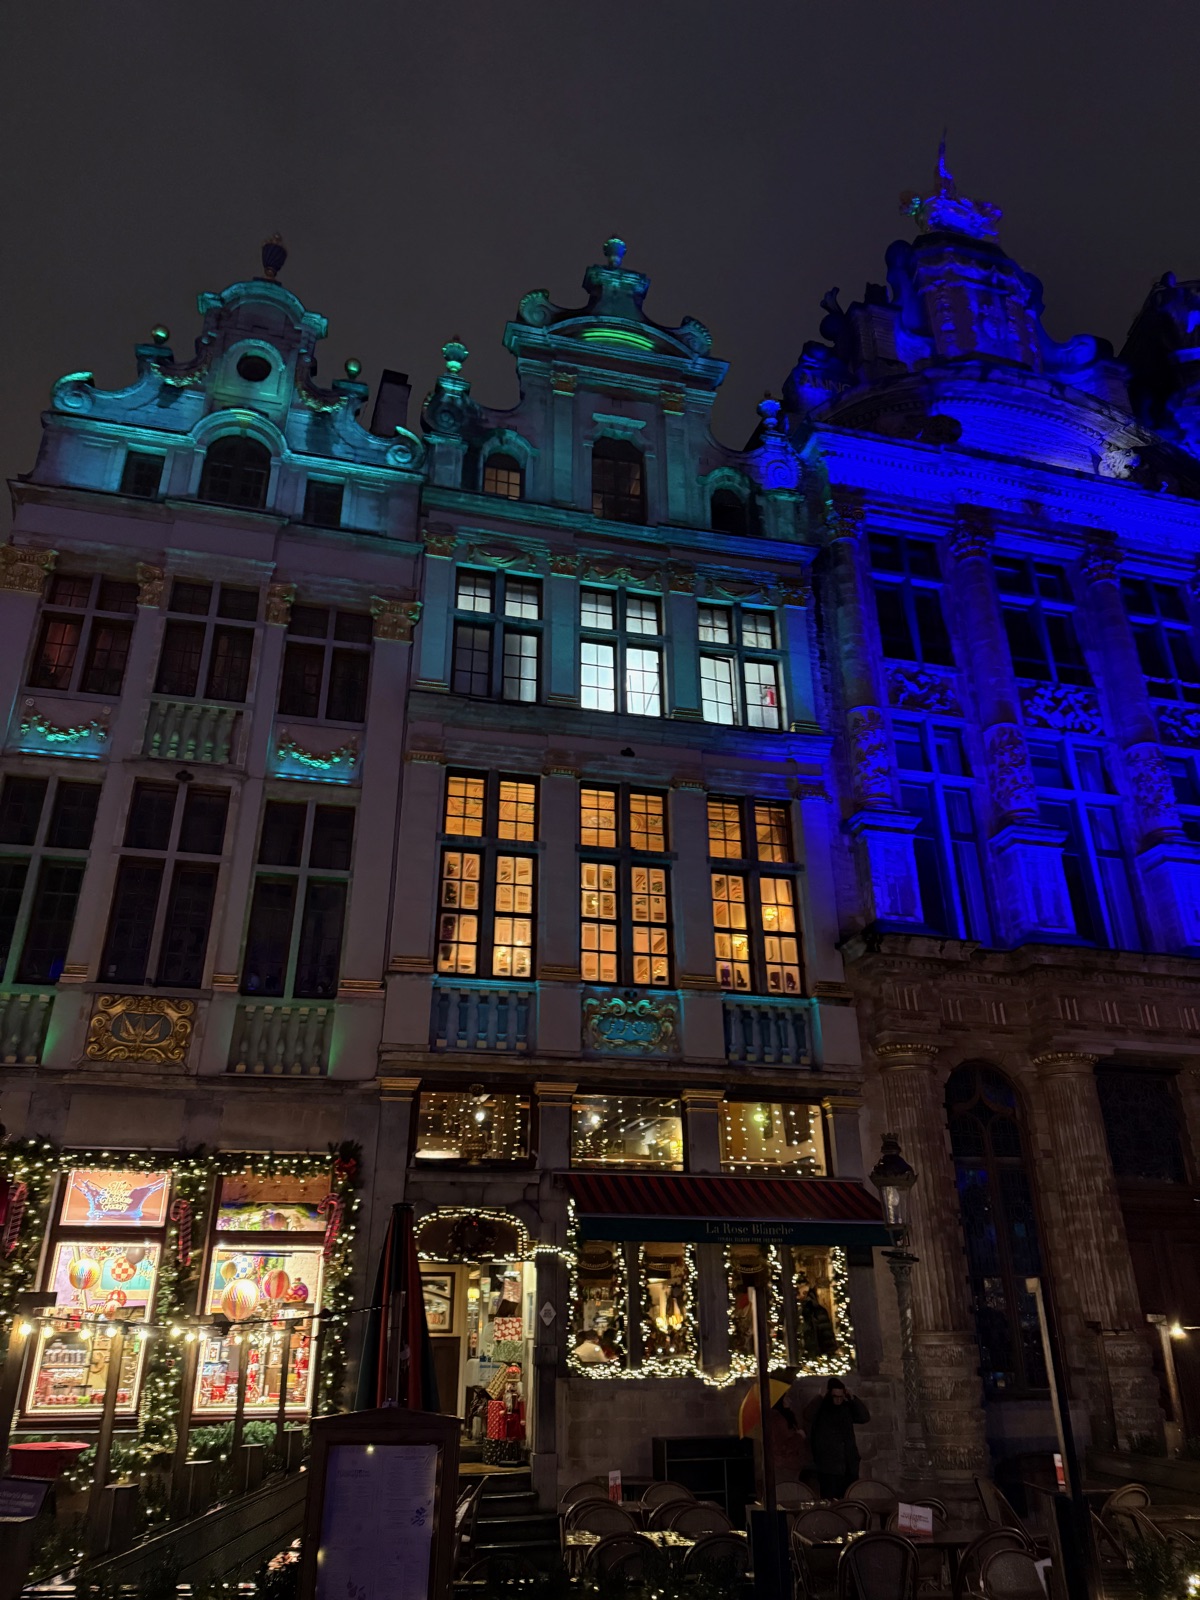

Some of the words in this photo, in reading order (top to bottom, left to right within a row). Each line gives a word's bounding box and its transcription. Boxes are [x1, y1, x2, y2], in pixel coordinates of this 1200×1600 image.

[706, 1222, 720, 1234] La
[723, 1222, 749, 1235] Rose
[752, 1223, 794, 1235] Blanche
